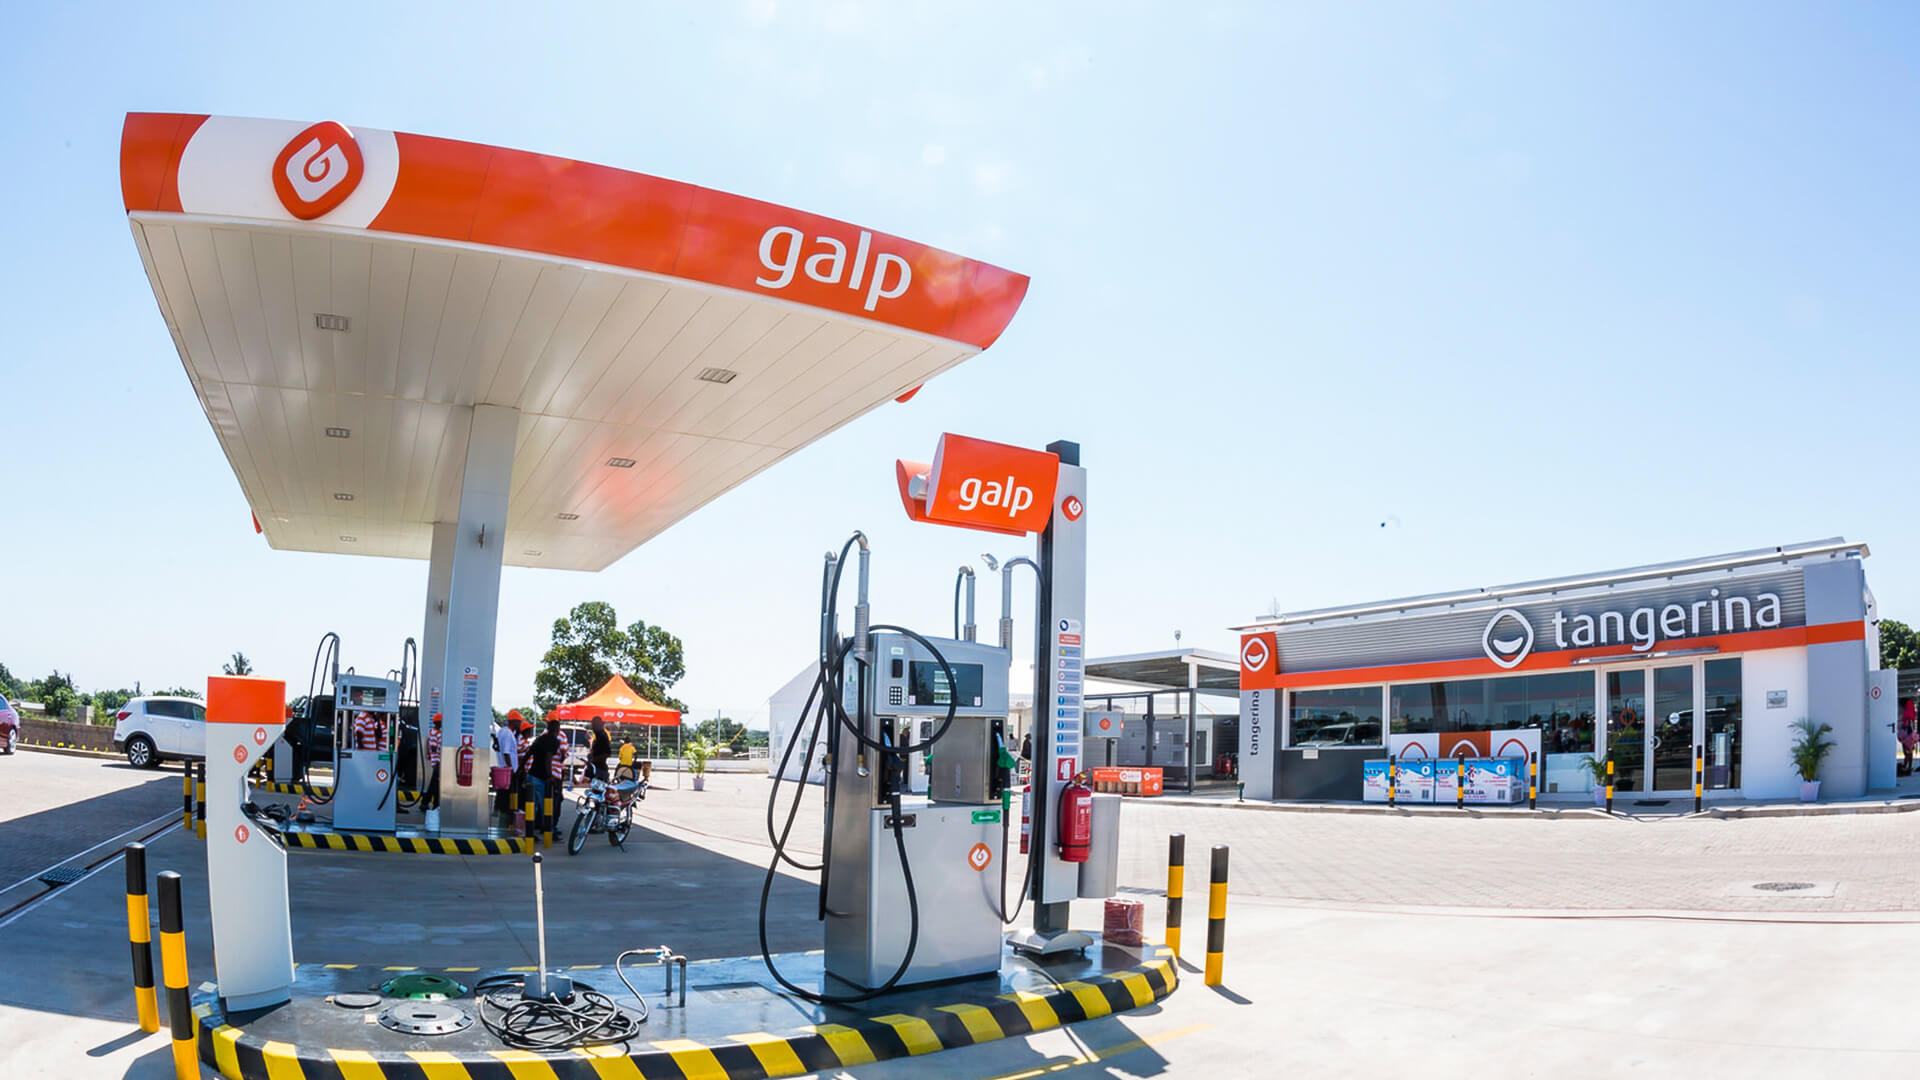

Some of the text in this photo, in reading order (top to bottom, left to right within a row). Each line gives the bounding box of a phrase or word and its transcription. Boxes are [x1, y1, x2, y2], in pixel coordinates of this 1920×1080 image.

[755, 225, 912, 312] galp
[958, 475, 1033, 518] galp
[1551, 588, 1782, 652] tangerina
[1249, 690, 1261, 756] tangerina
